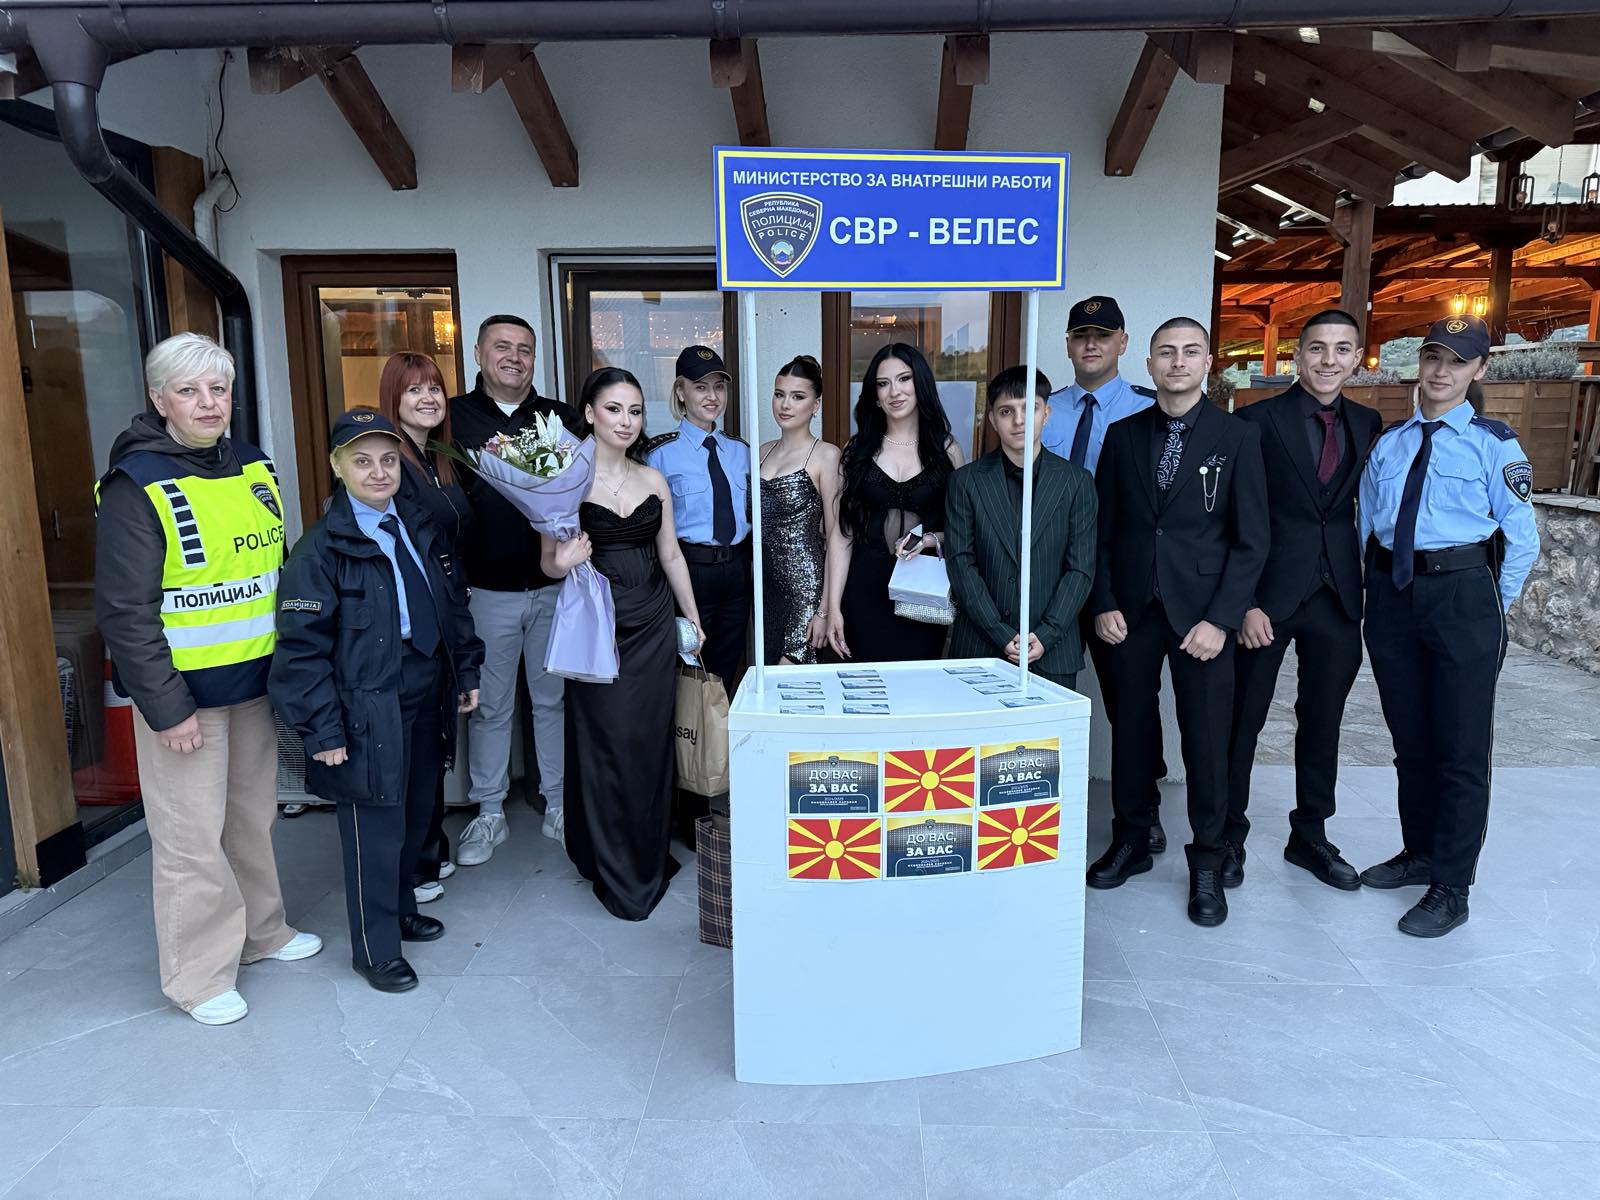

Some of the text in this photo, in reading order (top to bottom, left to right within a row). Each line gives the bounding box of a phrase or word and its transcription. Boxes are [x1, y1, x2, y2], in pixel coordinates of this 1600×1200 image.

[733, 171, 1052, 189] МИНИСТЕРСТВО ЗА ВНАТРЕШНИ РАБОТИ
[748, 206, 815, 218] СЕВЕРНА МАКЕДОНИЈА
[751, 215, 812, 231] ПОЛИЦИЈА
[758, 228, 806, 241] POLICE
[829, 216, 898, 245] СВР
[929, 217, 1039, 245] ВЕЛЕС
[233, 525, 283, 553] POLICE
[174, 582, 262, 608] ПОЛИЦИЈА
[674, 725, 698, 745] say
[998, 757, 1045, 772] ДО ВАС,
[809, 769, 861, 781] ДО ВАС,
[998, 771, 1042, 784] ЗА ВАС
[809, 783, 858, 793] ЗА ВАС
[906, 832, 957, 845] ДО ВАС,
[906, 845, 953, 857] ЗА ВАС
